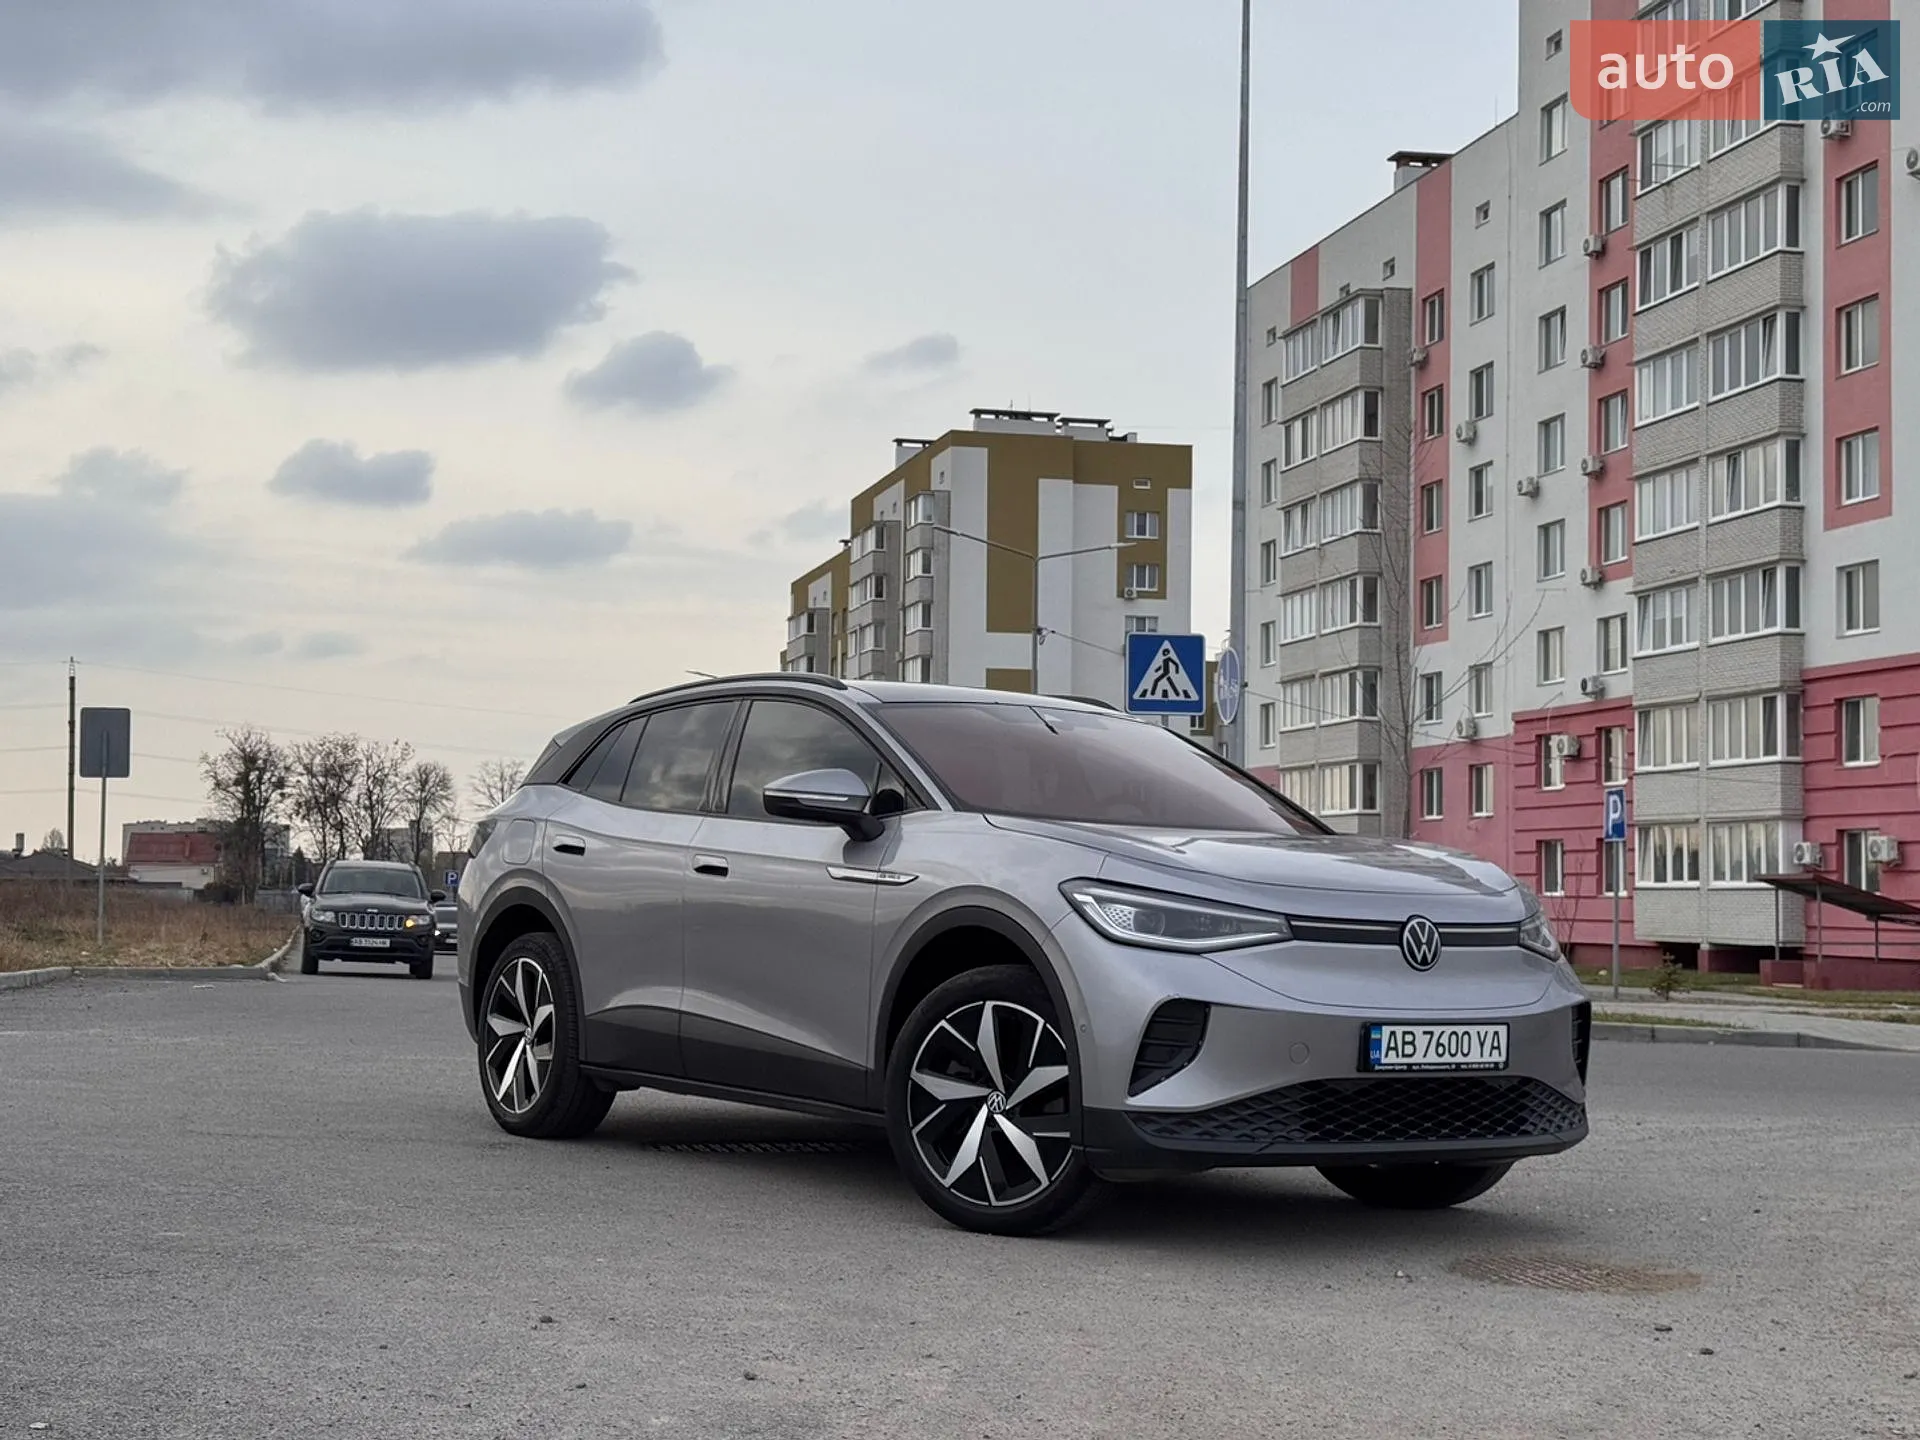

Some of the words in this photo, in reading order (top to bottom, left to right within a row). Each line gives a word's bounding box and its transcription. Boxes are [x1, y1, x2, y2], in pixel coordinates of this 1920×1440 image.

[1608, 794, 1622, 836] P
[447, 872, 457, 885] P
[1384, 1030, 1417, 1058] AB
[1422, 1030, 1471, 1058] 7600
[1477, 1030, 1502, 1058] YA
